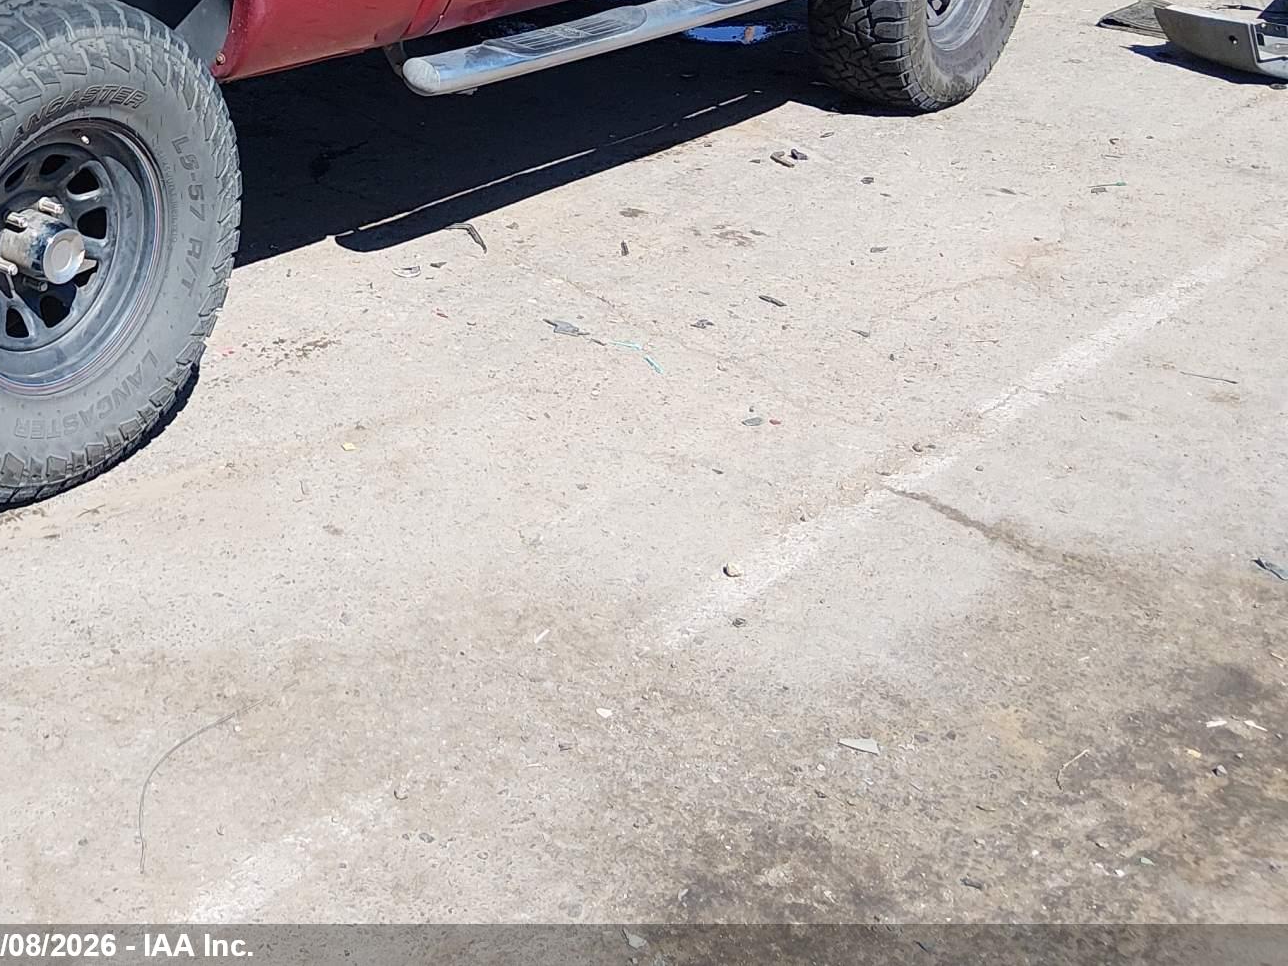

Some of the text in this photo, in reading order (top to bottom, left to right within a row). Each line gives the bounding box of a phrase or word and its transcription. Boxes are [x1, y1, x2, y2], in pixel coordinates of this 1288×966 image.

[171, 136, 206, 297] LS-57 R/T
[15, 348, 159, 440] LANCASTER
